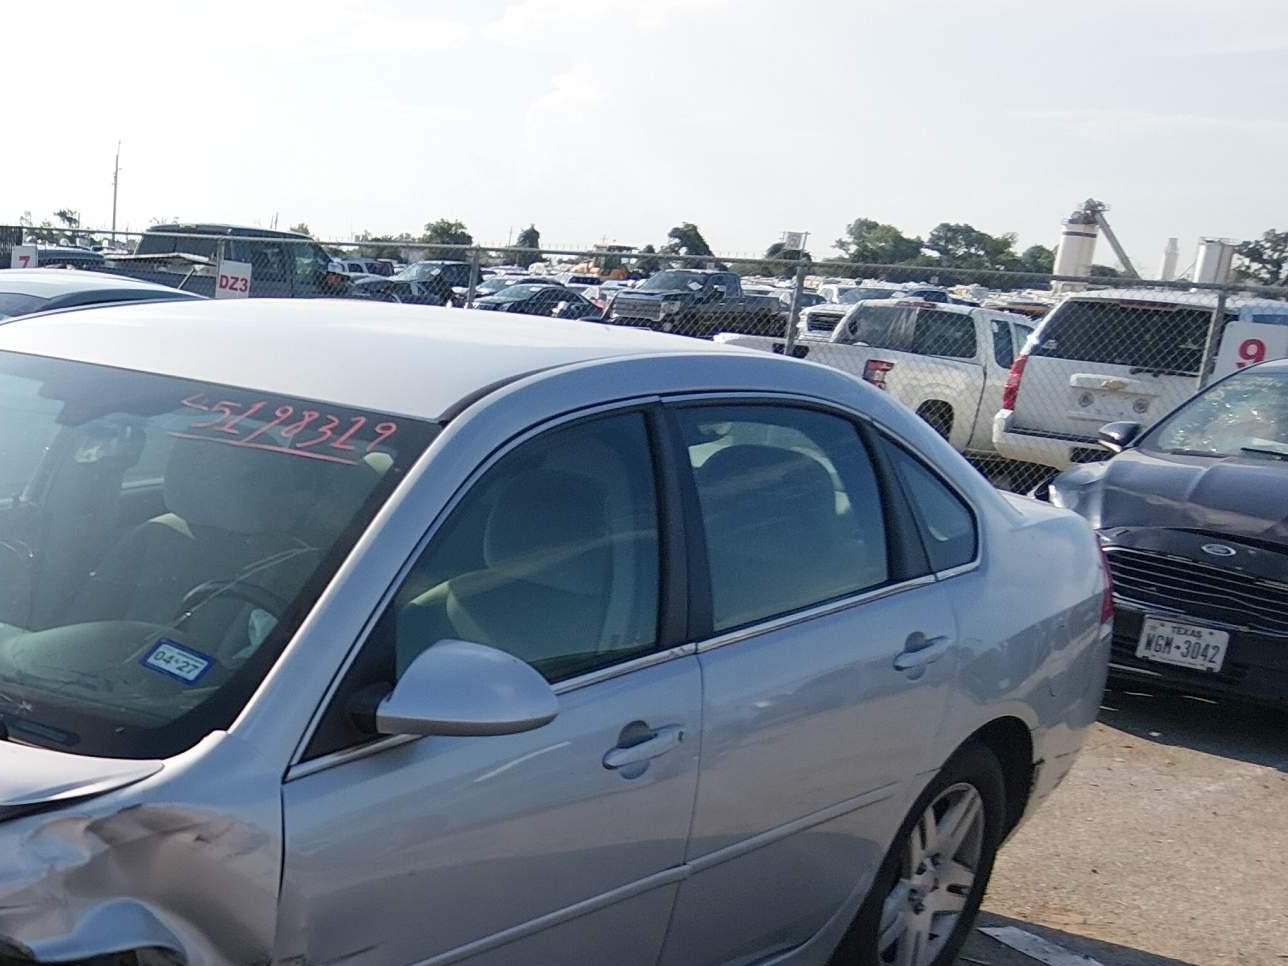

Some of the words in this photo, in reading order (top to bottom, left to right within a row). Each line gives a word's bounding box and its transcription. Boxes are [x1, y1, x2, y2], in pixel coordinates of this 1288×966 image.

[18, 255, 31, 269] 7
[218, 274, 249, 293] DZ3
[1236, 338, 1266, 369] 9
[1171, 625, 1203, 639] TEXAS
